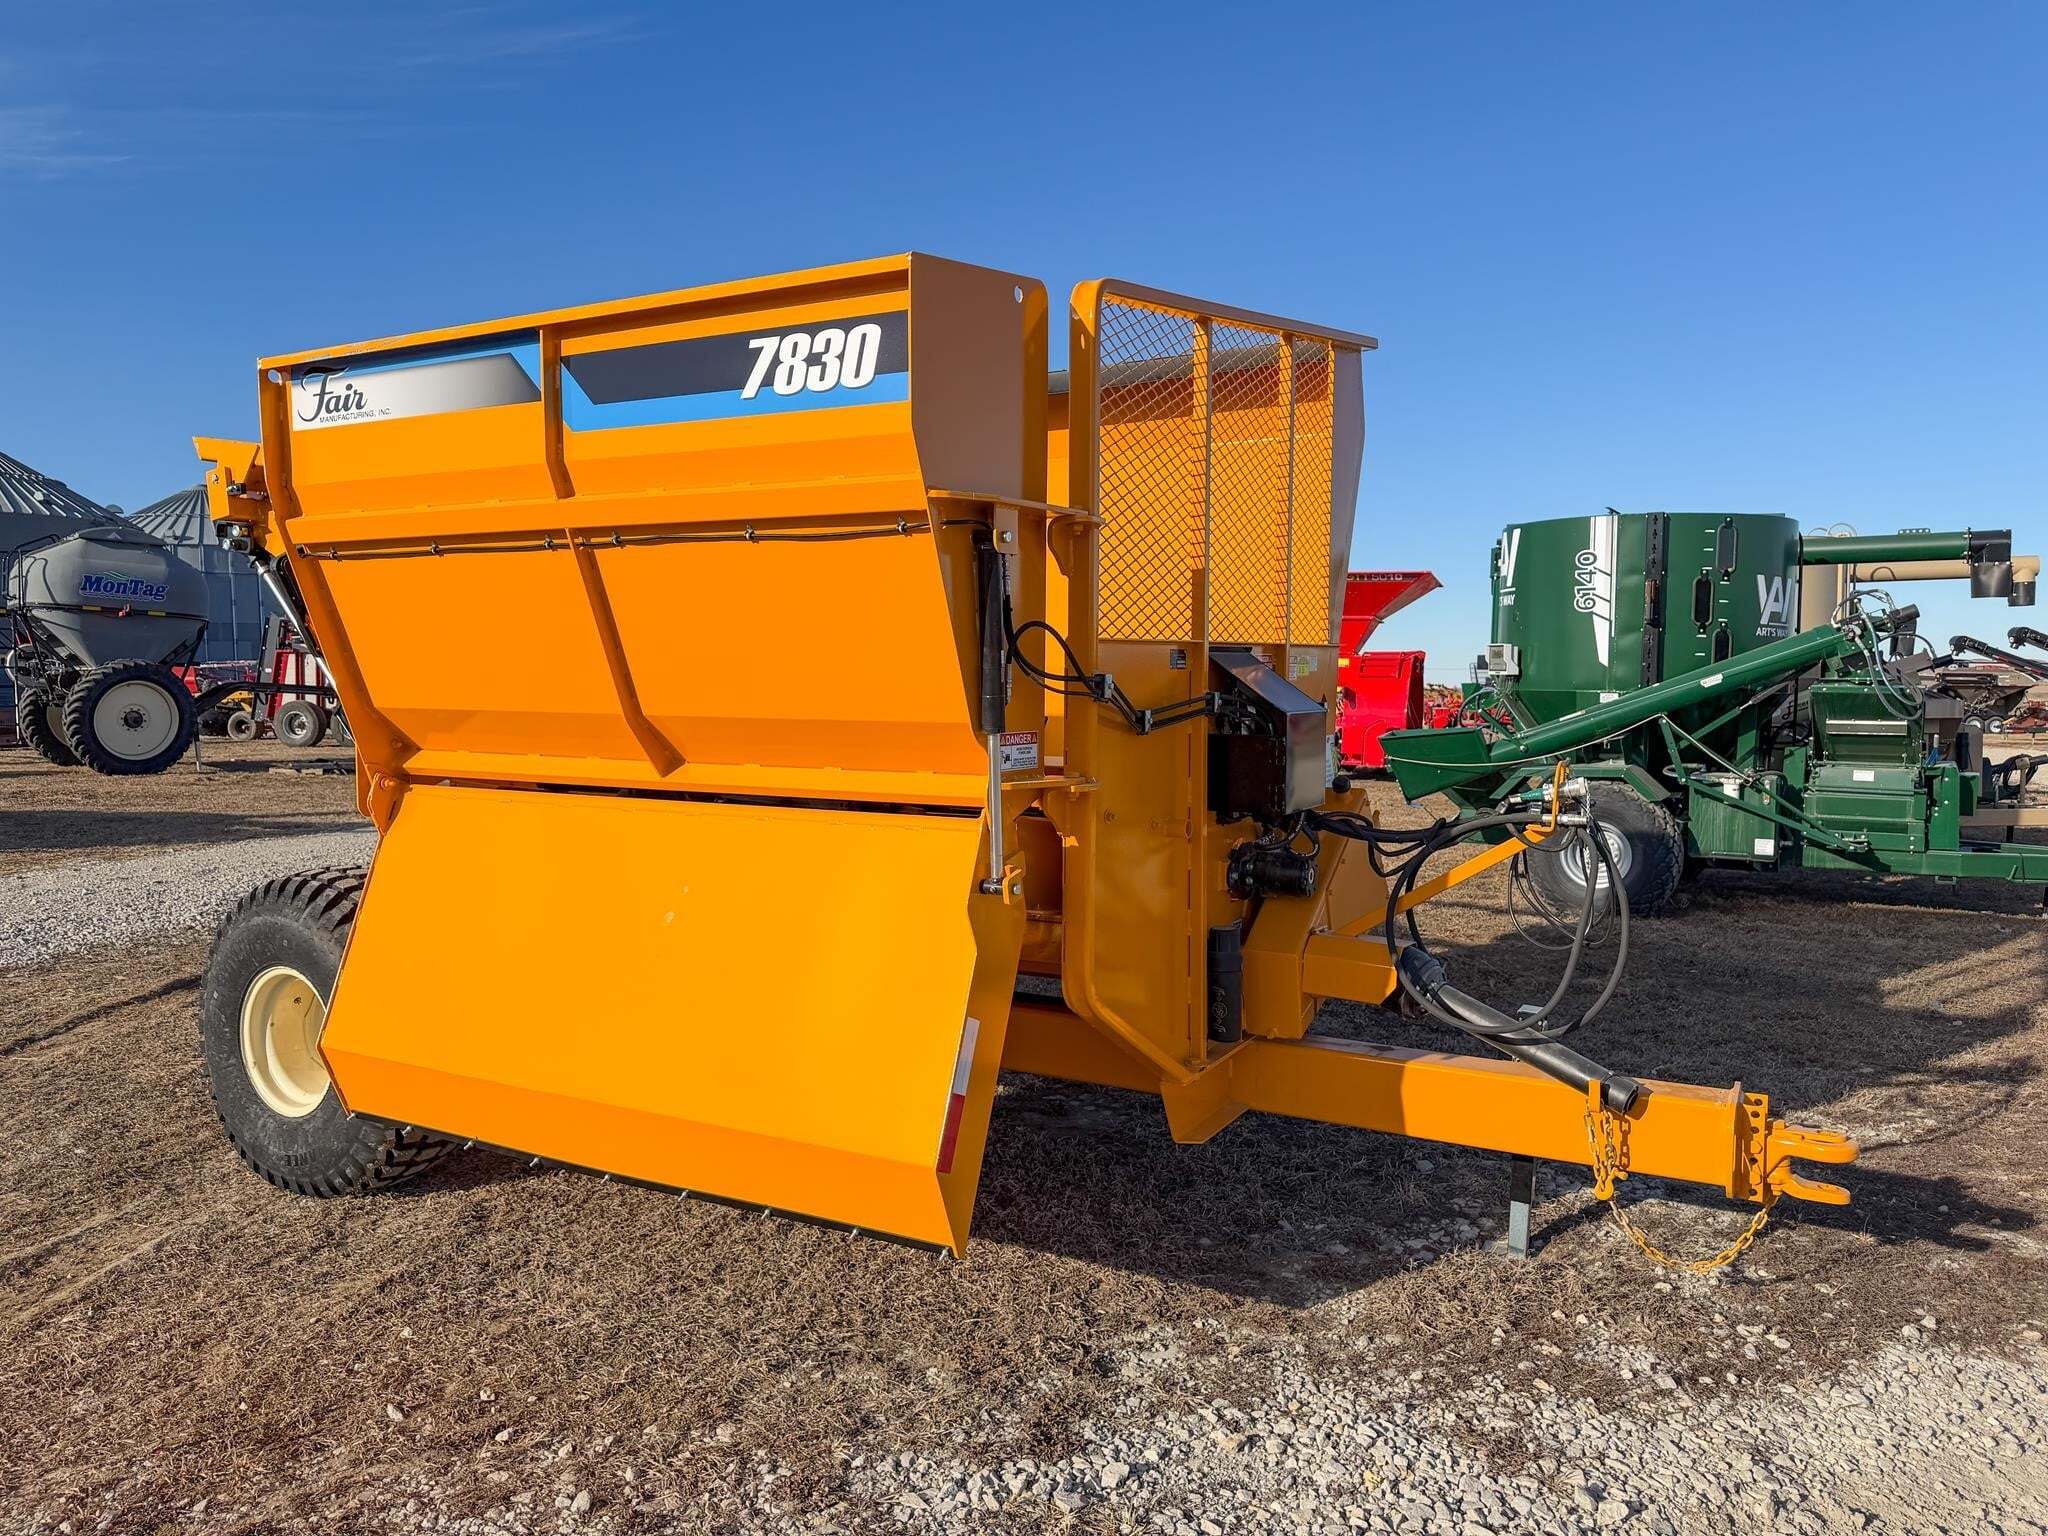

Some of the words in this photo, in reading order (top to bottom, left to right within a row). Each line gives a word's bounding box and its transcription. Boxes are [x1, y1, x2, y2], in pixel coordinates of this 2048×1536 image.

[740, 323, 882, 400] 7830
[298, 366, 368, 422] Fair
[79, 573, 169, 602] MonTag
[1574, 549, 1598, 613] 6140
[1005, 733, 1032, 745] DANGER
